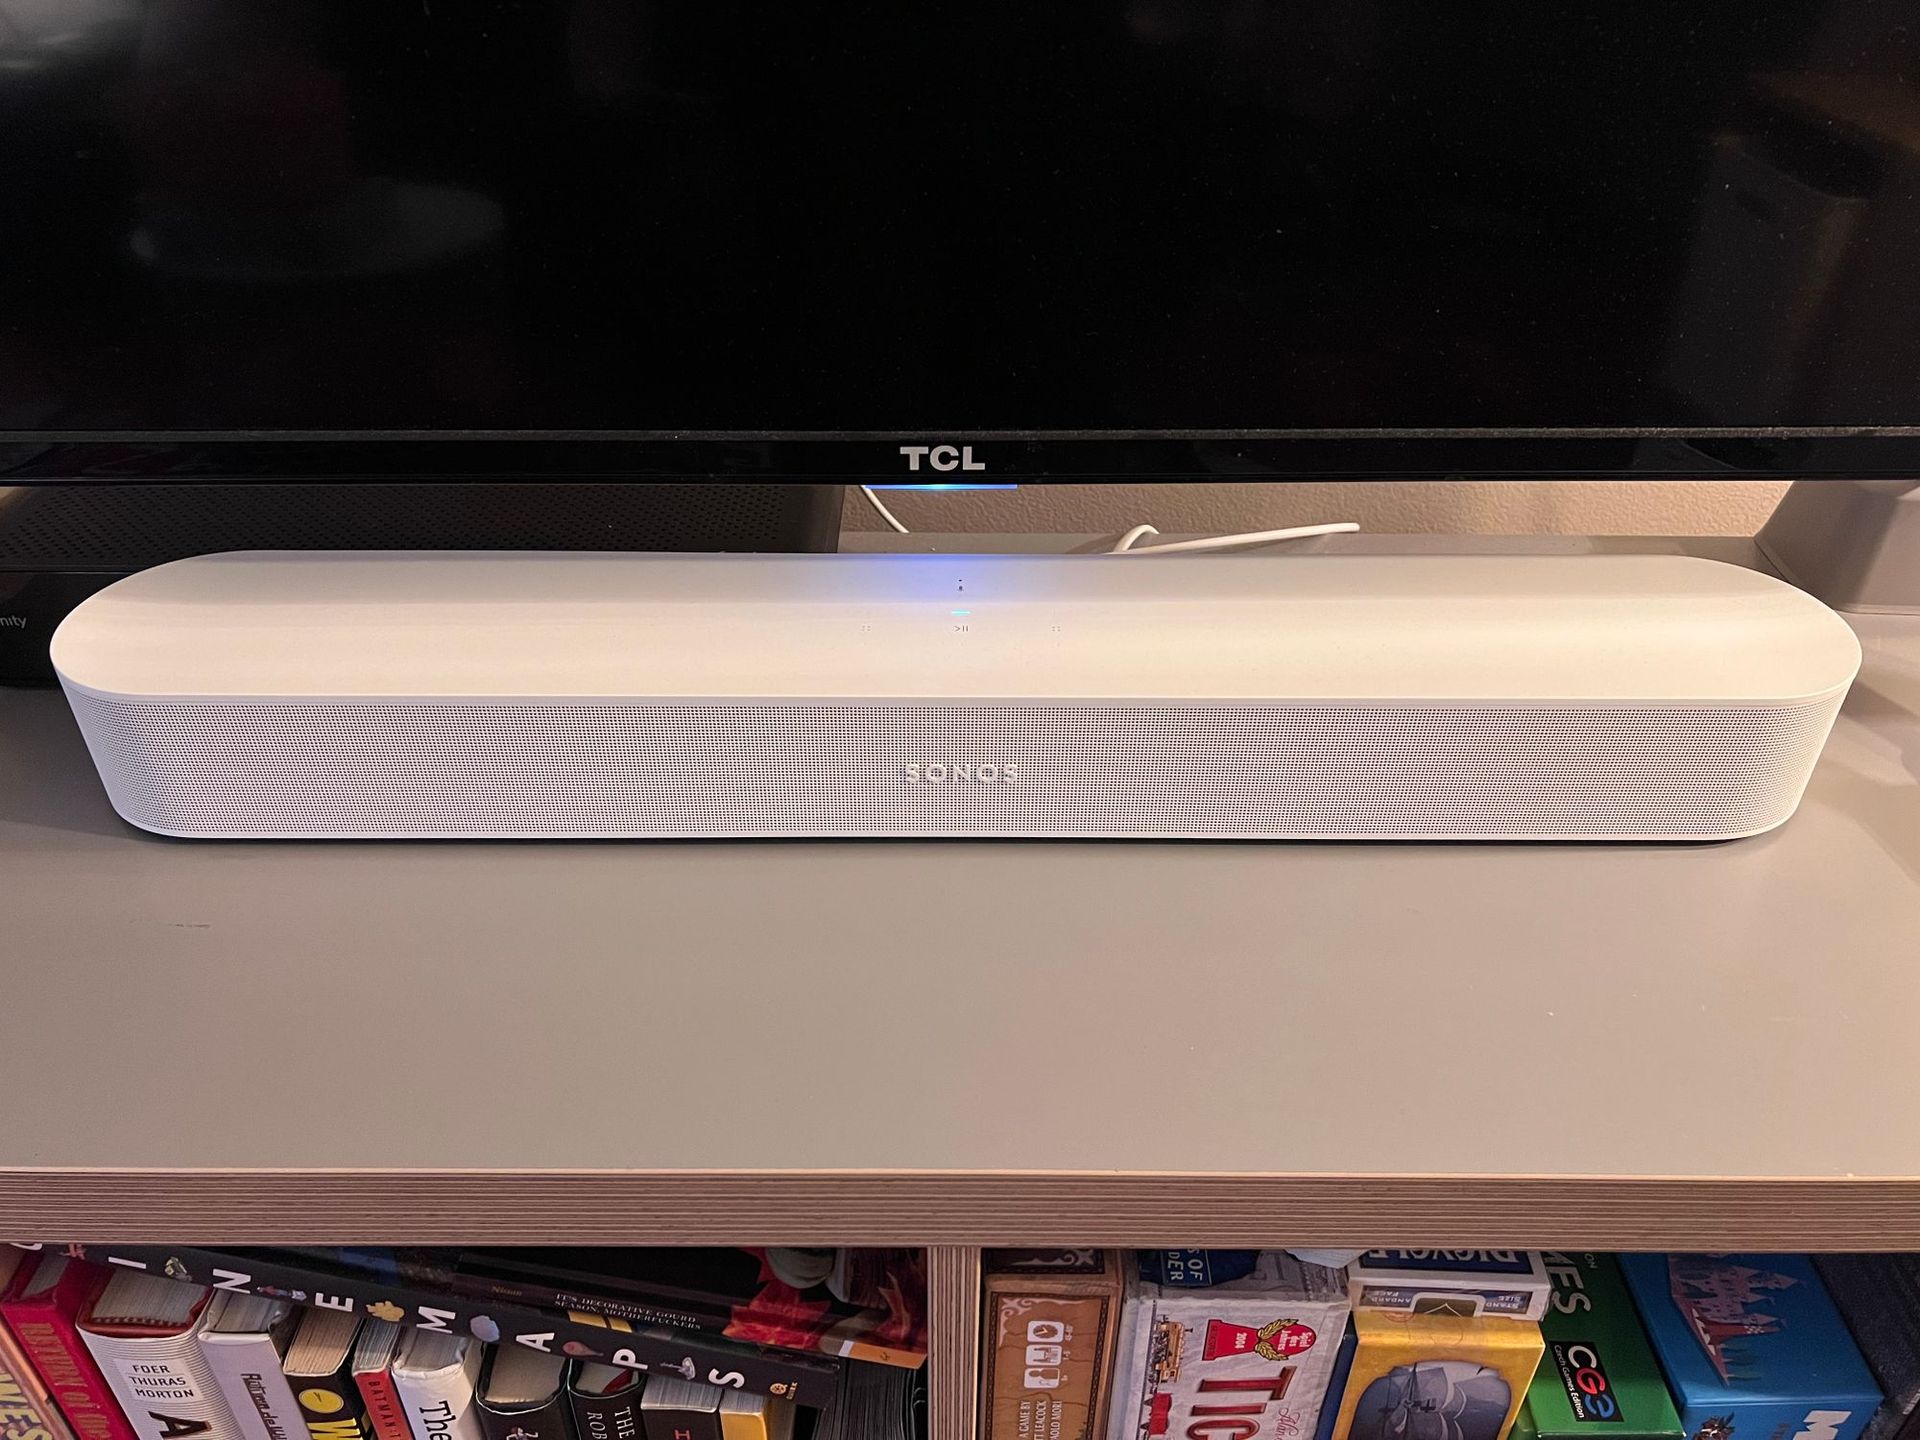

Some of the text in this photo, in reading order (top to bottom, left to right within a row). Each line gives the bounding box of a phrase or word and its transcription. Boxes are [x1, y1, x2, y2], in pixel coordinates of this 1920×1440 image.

[900, 445, 986, 471] TCL
[905, 763, 1019, 784] SONOS
[1188, 1258, 1203, 1281] OF
[556, 1293, 697, 1323] IT'S DECORATIVE GOURD
[603, 1309, 702, 1330] MOTHERFUCKERS
[1235, 1332, 1248, 1349] 2004
[132, 1364, 171, 1374] FOER
[128, 1376, 187, 1387] THURAS
[1554, 1344, 1585, 1419] Czech Games Edition
[135, 1388, 194, 1398] MORTON
[1020, 1401, 1031, 1411] BY
[1035, 1401, 1047, 1432] LEACOCK
[614, 1406, 636, 1440] THE
[1019, 1411, 1031, 1432] GAME
